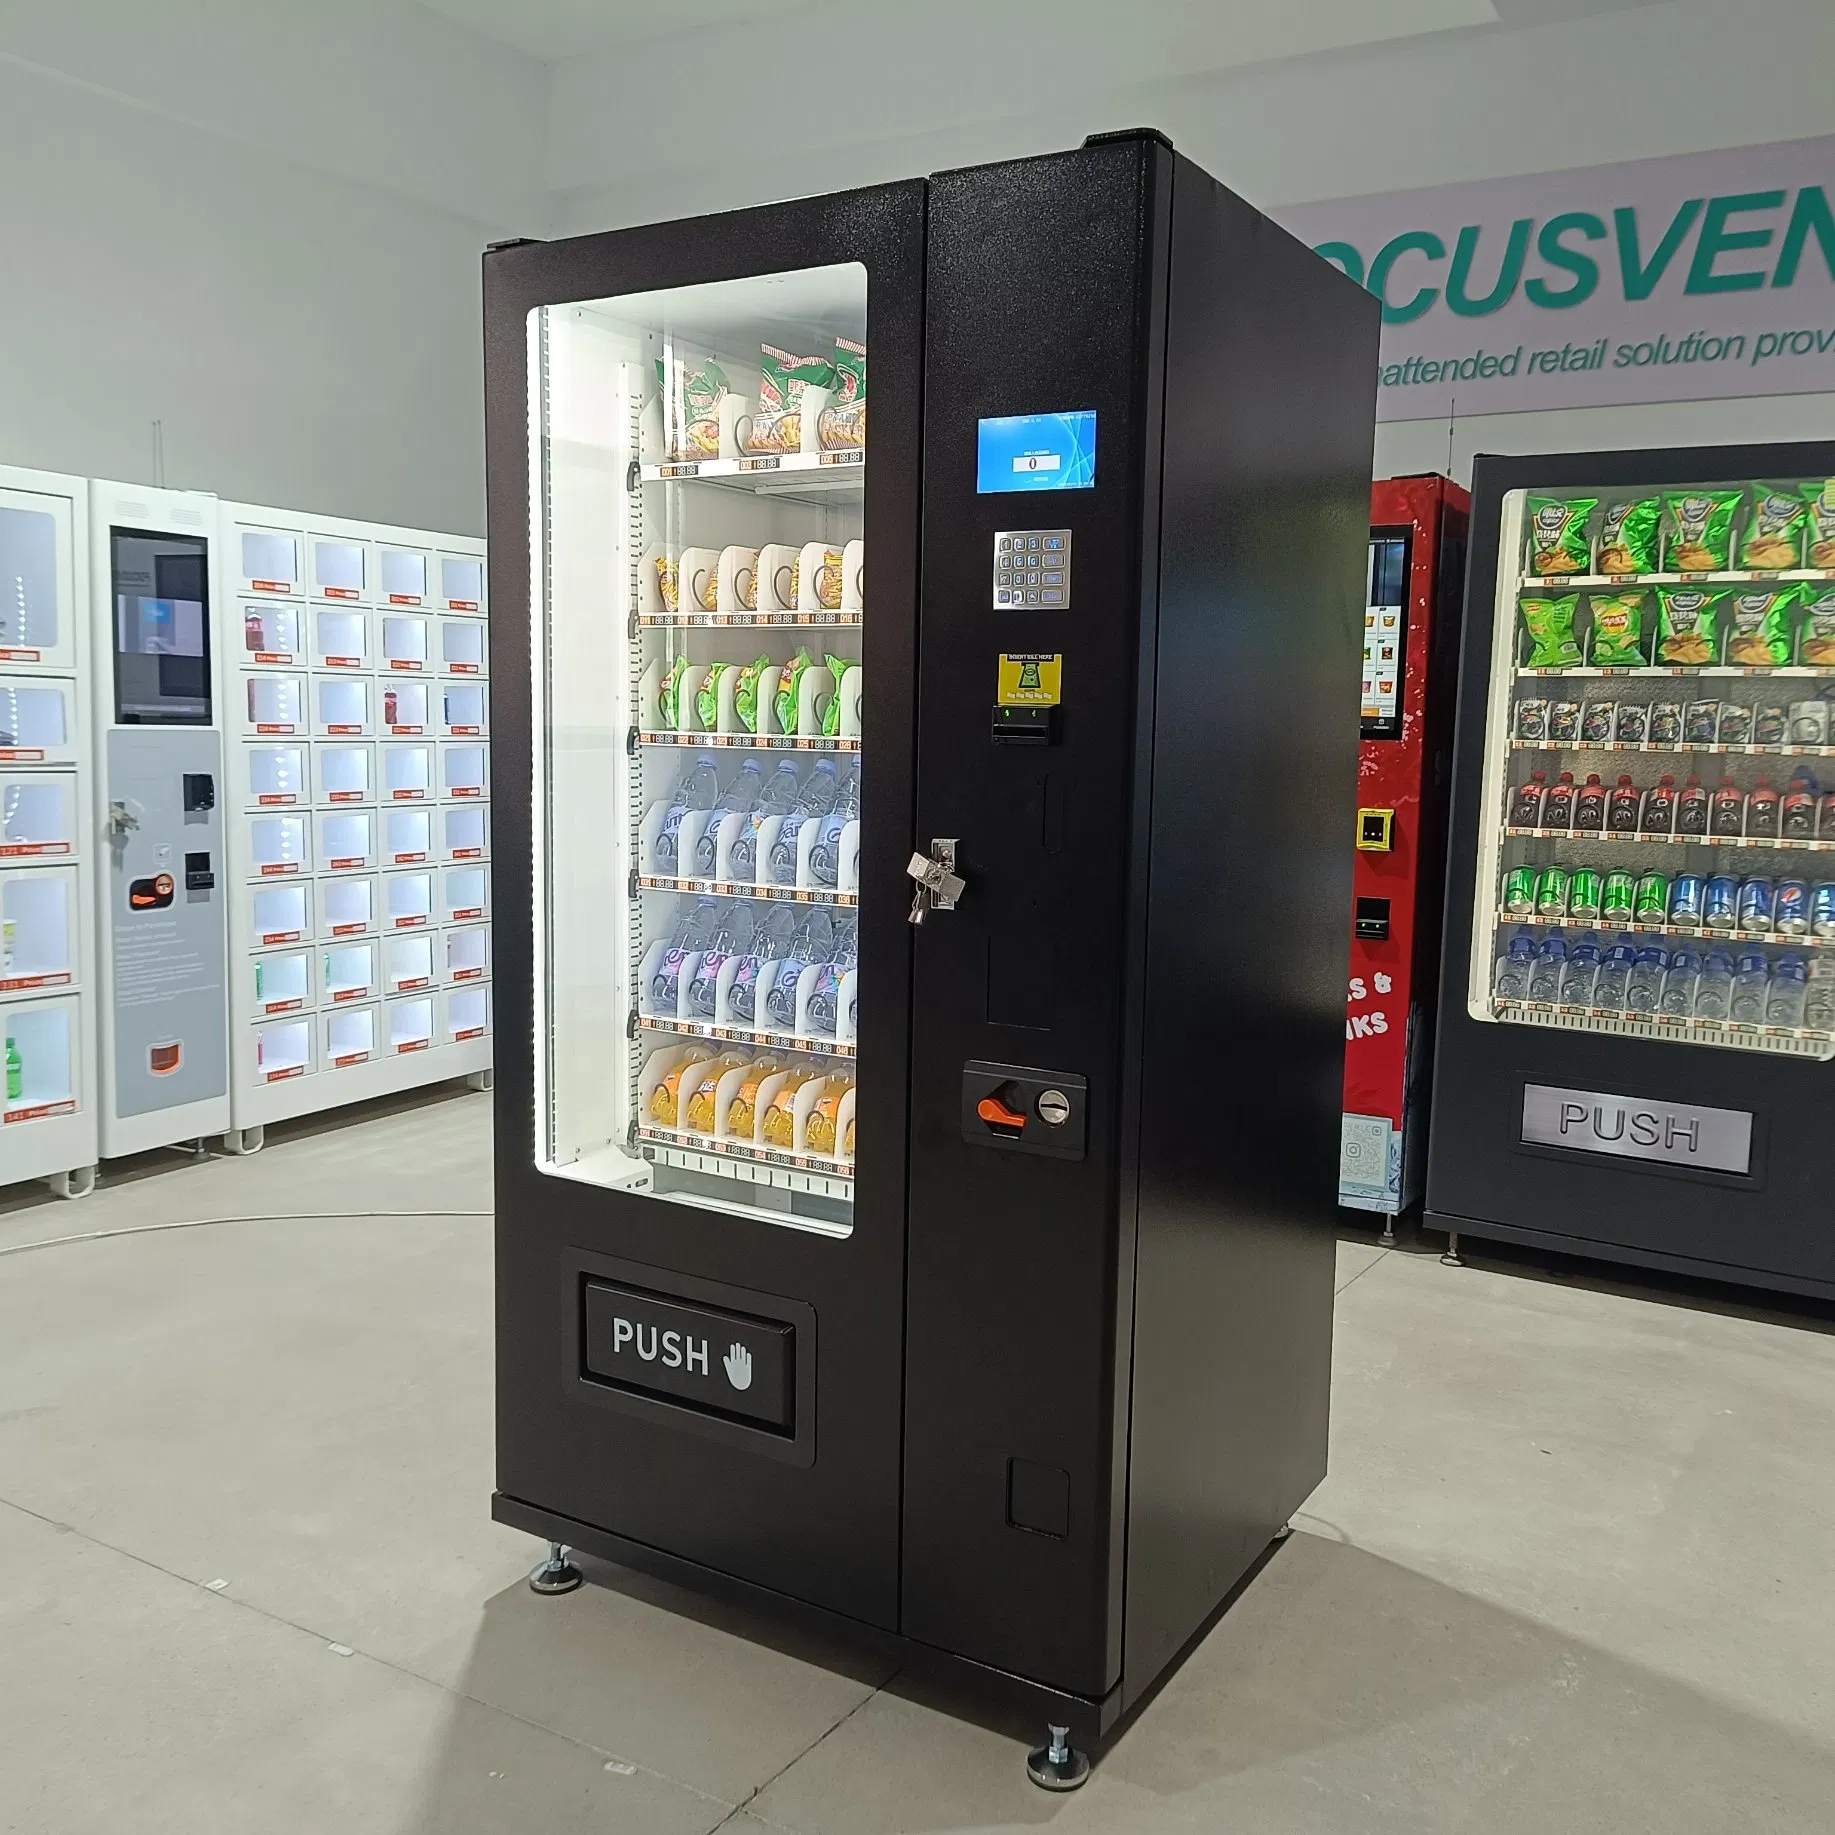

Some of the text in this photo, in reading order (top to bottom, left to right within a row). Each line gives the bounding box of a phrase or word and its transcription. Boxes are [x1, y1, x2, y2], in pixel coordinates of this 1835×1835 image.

[1378, 346, 1522, 388] attended
[1527, 337, 1606, 377] retail
[1613, 330, 1746, 369] solution
[1029, 457, 1037, 470] 0
[1374, 972, 1391, 993] &
[1559, 1101, 1700, 1152] PUSH
[613, 1317, 708, 1376] PUSH
